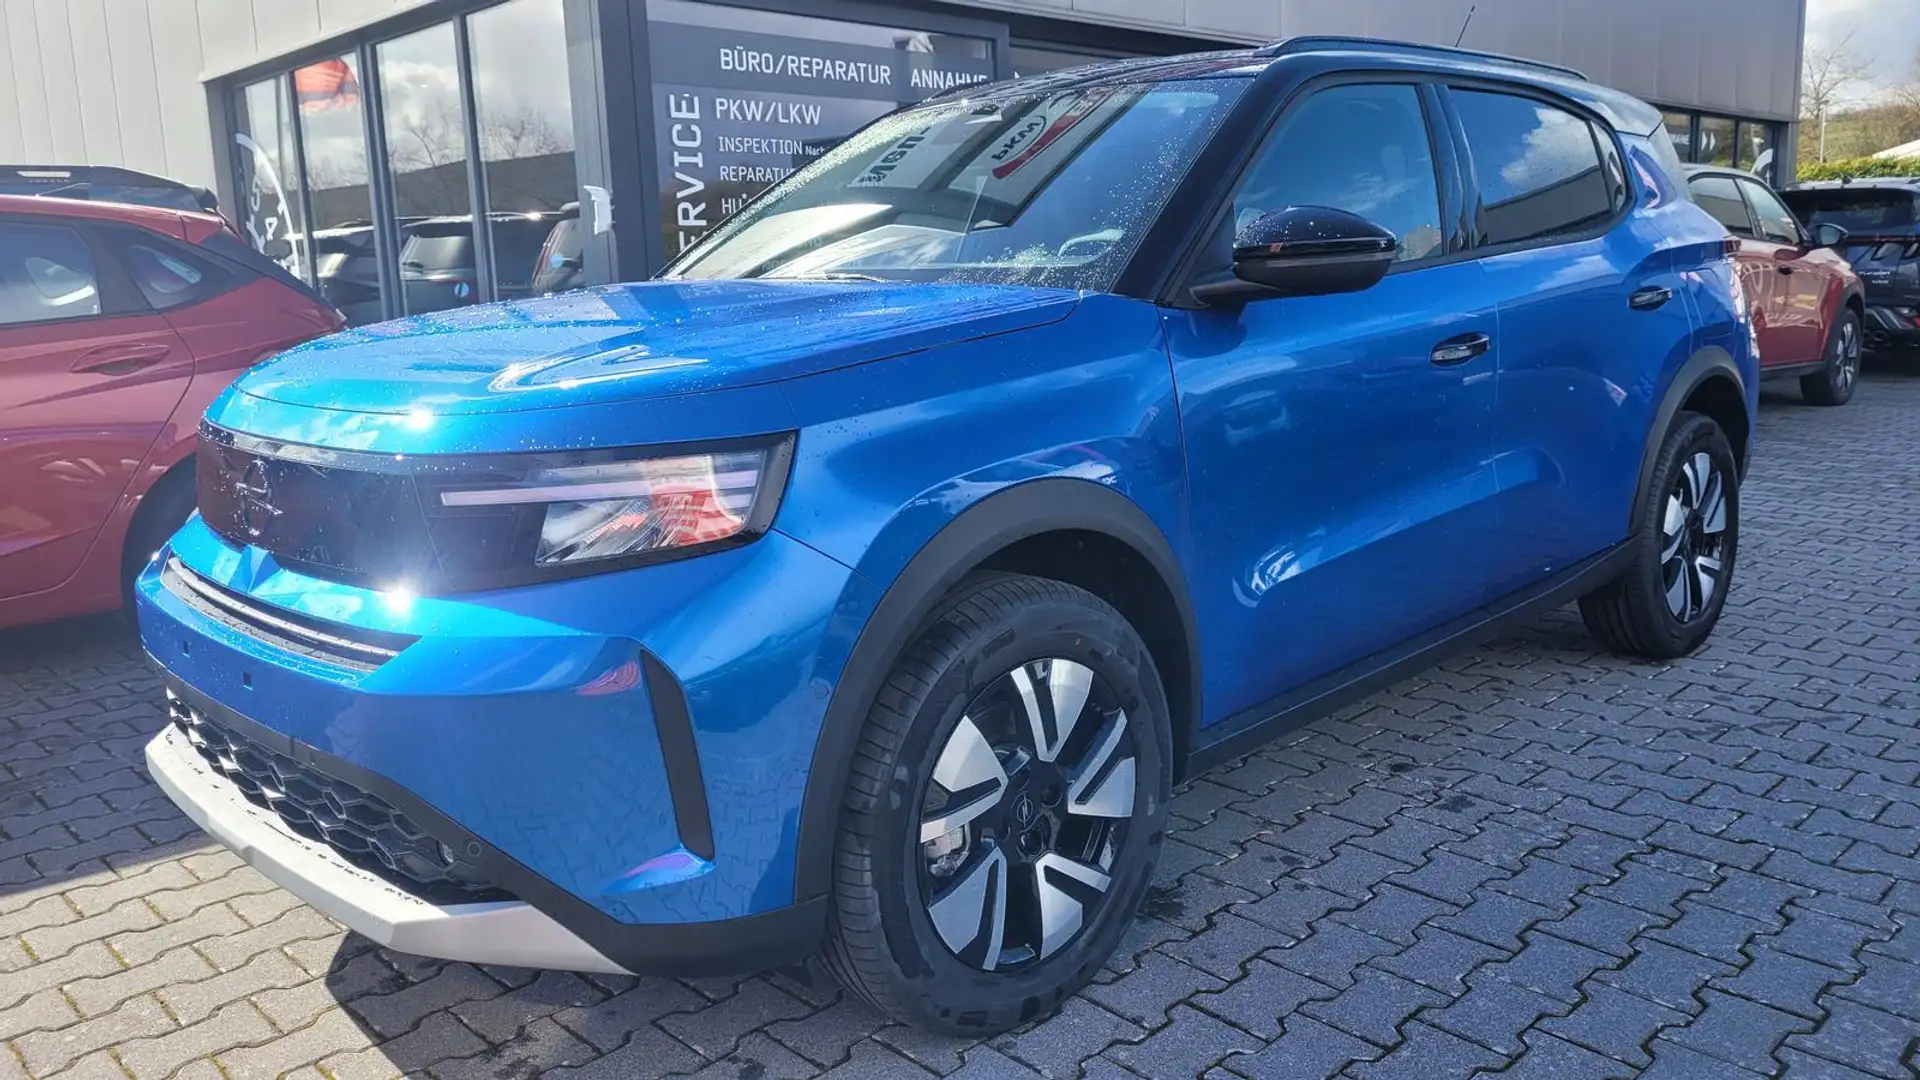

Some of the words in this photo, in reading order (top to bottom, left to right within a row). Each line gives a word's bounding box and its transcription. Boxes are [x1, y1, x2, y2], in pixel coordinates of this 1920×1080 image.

[720, 46, 891, 85] BÜRO/REPARATUR
[715, 98, 821, 125] PKW/LKW
[718, 136, 803, 155] INSPEKTION
[720, 166, 797, 182] REPARATU
